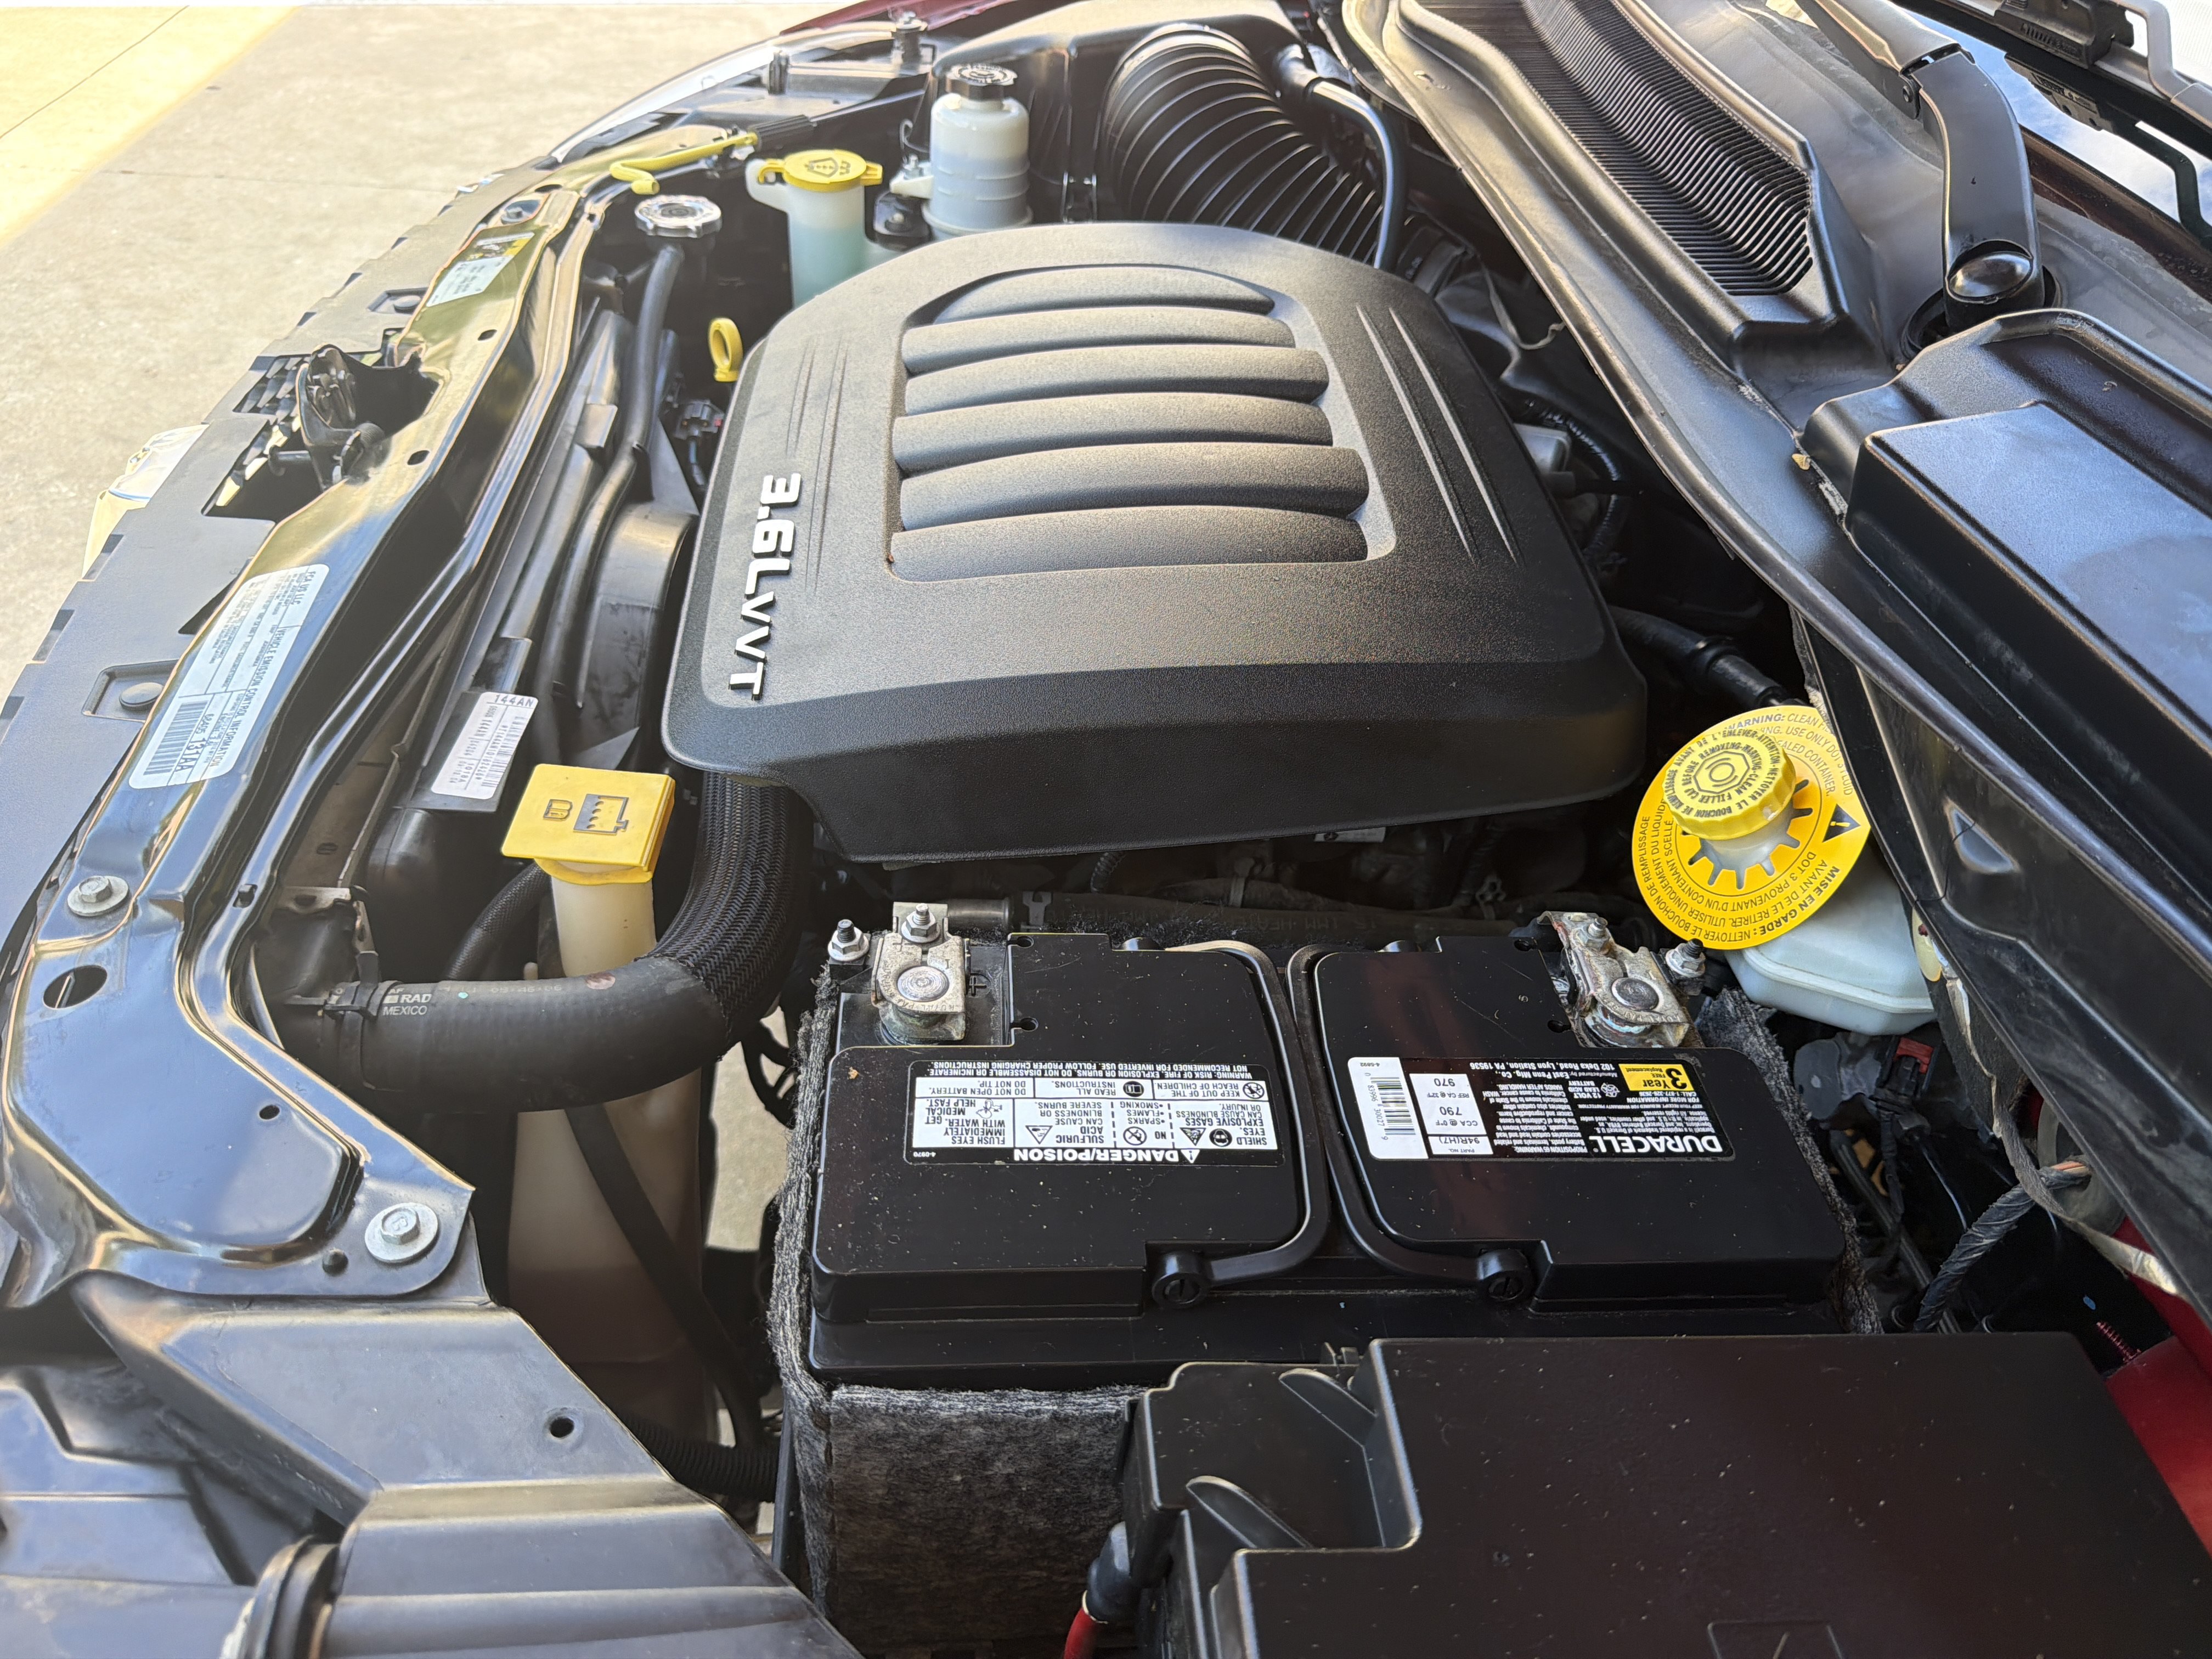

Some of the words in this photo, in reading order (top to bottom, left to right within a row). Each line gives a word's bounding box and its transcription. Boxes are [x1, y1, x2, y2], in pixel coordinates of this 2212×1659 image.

[304, 571, 317, 583] FCA
[267, 628, 287, 656] VEHICLE
[252, 655, 274, 686] EMISSION
[235, 688, 258, 718] CONTROL
[494, 695, 534, 707] 144AN
[1787, 713, 1819, 726] CLEAN
[210, 720, 242, 767] INFORMATION
[1785, 726, 1805, 737] USE
[1805, 730, 1831, 747] ONLY
[175, 737, 208, 772] 131AA
[1804, 750, 1836, 797] CONTAINER.
[1638, 816, 1652, 882] REMPLISSAGE
[1651, 841, 1660, 855] DU
[1797, 851, 1817, 874] DOT
[1666, 859, 1705, 905] CONTENANT
[1789, 872, 1798, 882] 3
[1799, 859, 1828, 894] AVANT
[1813, 866, 1841, 896] MISE
[1646, 883, 1658, 897] DE
[1652, 859, 1689, 912] UNIQUEMENT
[1730, 879, 1791, 912] PROVENANT
[1784, 891, 1800, 906] DE
[1798, 894, 1815, 911] EN
[1705, 898, 1729, 912] D'UN
[1771, 904, 1785, 915] LE
[1654, 895, 1691, 932] BOUCHON
[1688, 907, 1726, 927] UTILISER
[1729, 908, 1770, 928] RETIRER.
[1690, 925, 1703, 936] LE
[1703, 929, 1751, 942] NETTOYER
[400, 994, 432, 1003] RAD
[383, 1006, 427, 1015] MEXICO
[1506, 1061, 1535, 1069] Station,
[1536, 1061, 1555, 1070] Lyon
[1433, 1078, 1455, 1086] 970
[1642, 1079, 1671, 1088] Year
[1665, 1068, 1686, 1088] 3
[926, 1098, 950, 1107] FAST.
[953, 1098, 975, 1107] HELP
[1367, 1085, 1375, 1102] 83996
[1374, 1108, 1385, 1126] 30027
[1439, 1106, 1462, 1115] 790
[945, 1118, 979, 1126] WATER.
[1056, 1135, 1103, 1143] SULFURIC
[1589, 1135, 1723, 1152] DURACELL
[1014, 1148, 1178, 1161] DANGER/POISON
